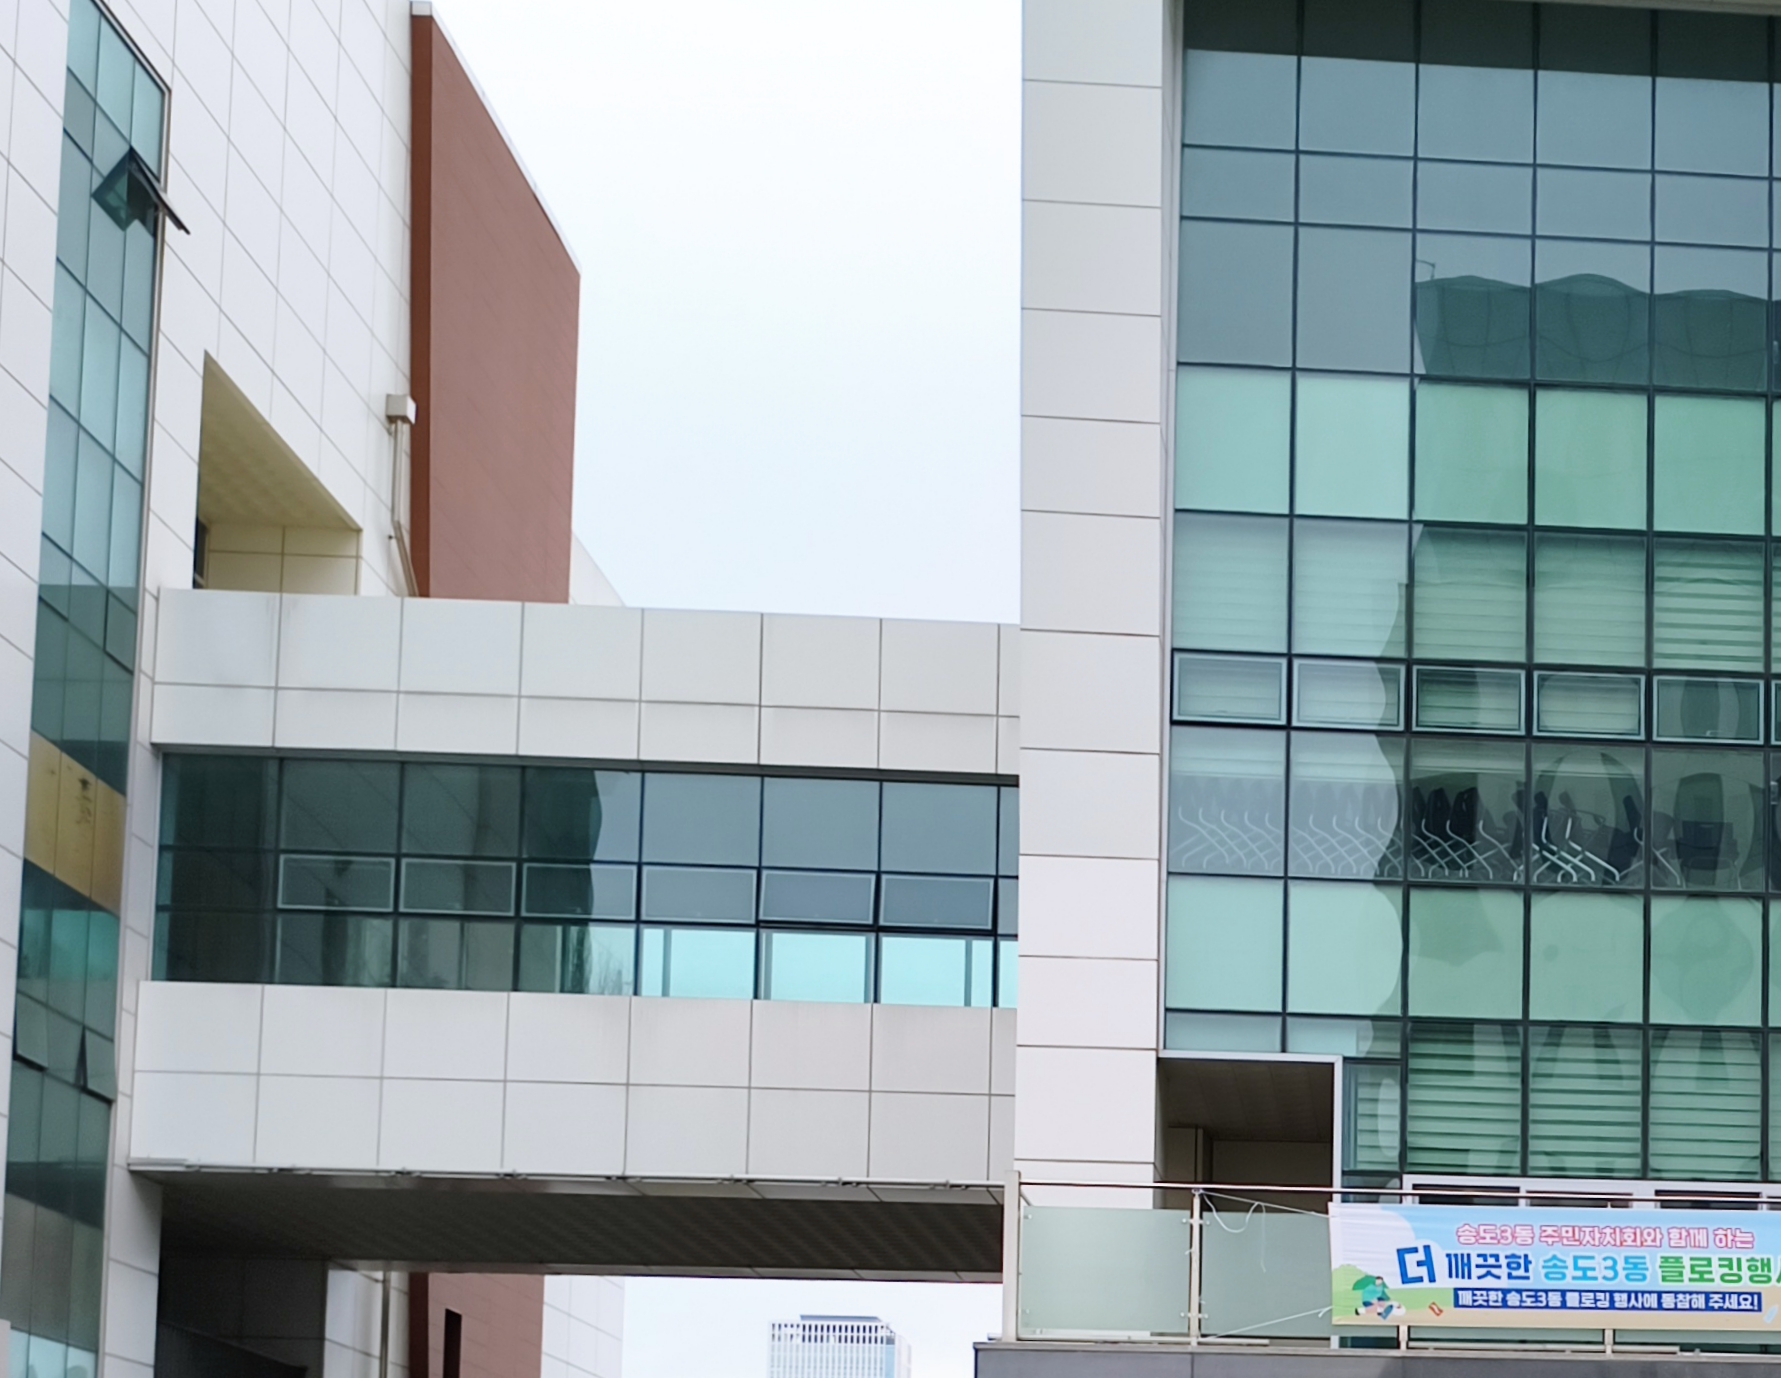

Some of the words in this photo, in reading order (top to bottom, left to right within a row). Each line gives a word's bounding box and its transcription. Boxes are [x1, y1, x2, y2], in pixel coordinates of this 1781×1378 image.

[1456, 1223, 1534, 1245] 송도3동
[1539, 1225, 1663, 1248] 주민자치회와
[1668, 1226, 1709, 1249] 함께
[1714, 1227, 1755, 1249] 하는
[1396, 1245, 1436, 1284] 더
[1446, 1252, 1532, 1281] 깨끗한
[1542, 1254, 1649, 1282] 송도3동
[1457, 1290, 1503, 1307] 깨끗한
[1506, 1291, 1562, 1307] 송도3동
[1566, 1292, 1610, 1308] 플로킹
[1614, 1292, 1658, 1309] 행사에
[1661, 1292, 1705, 1309] 동참해
[1708, 1293, 1758, 1311] 주세요!
